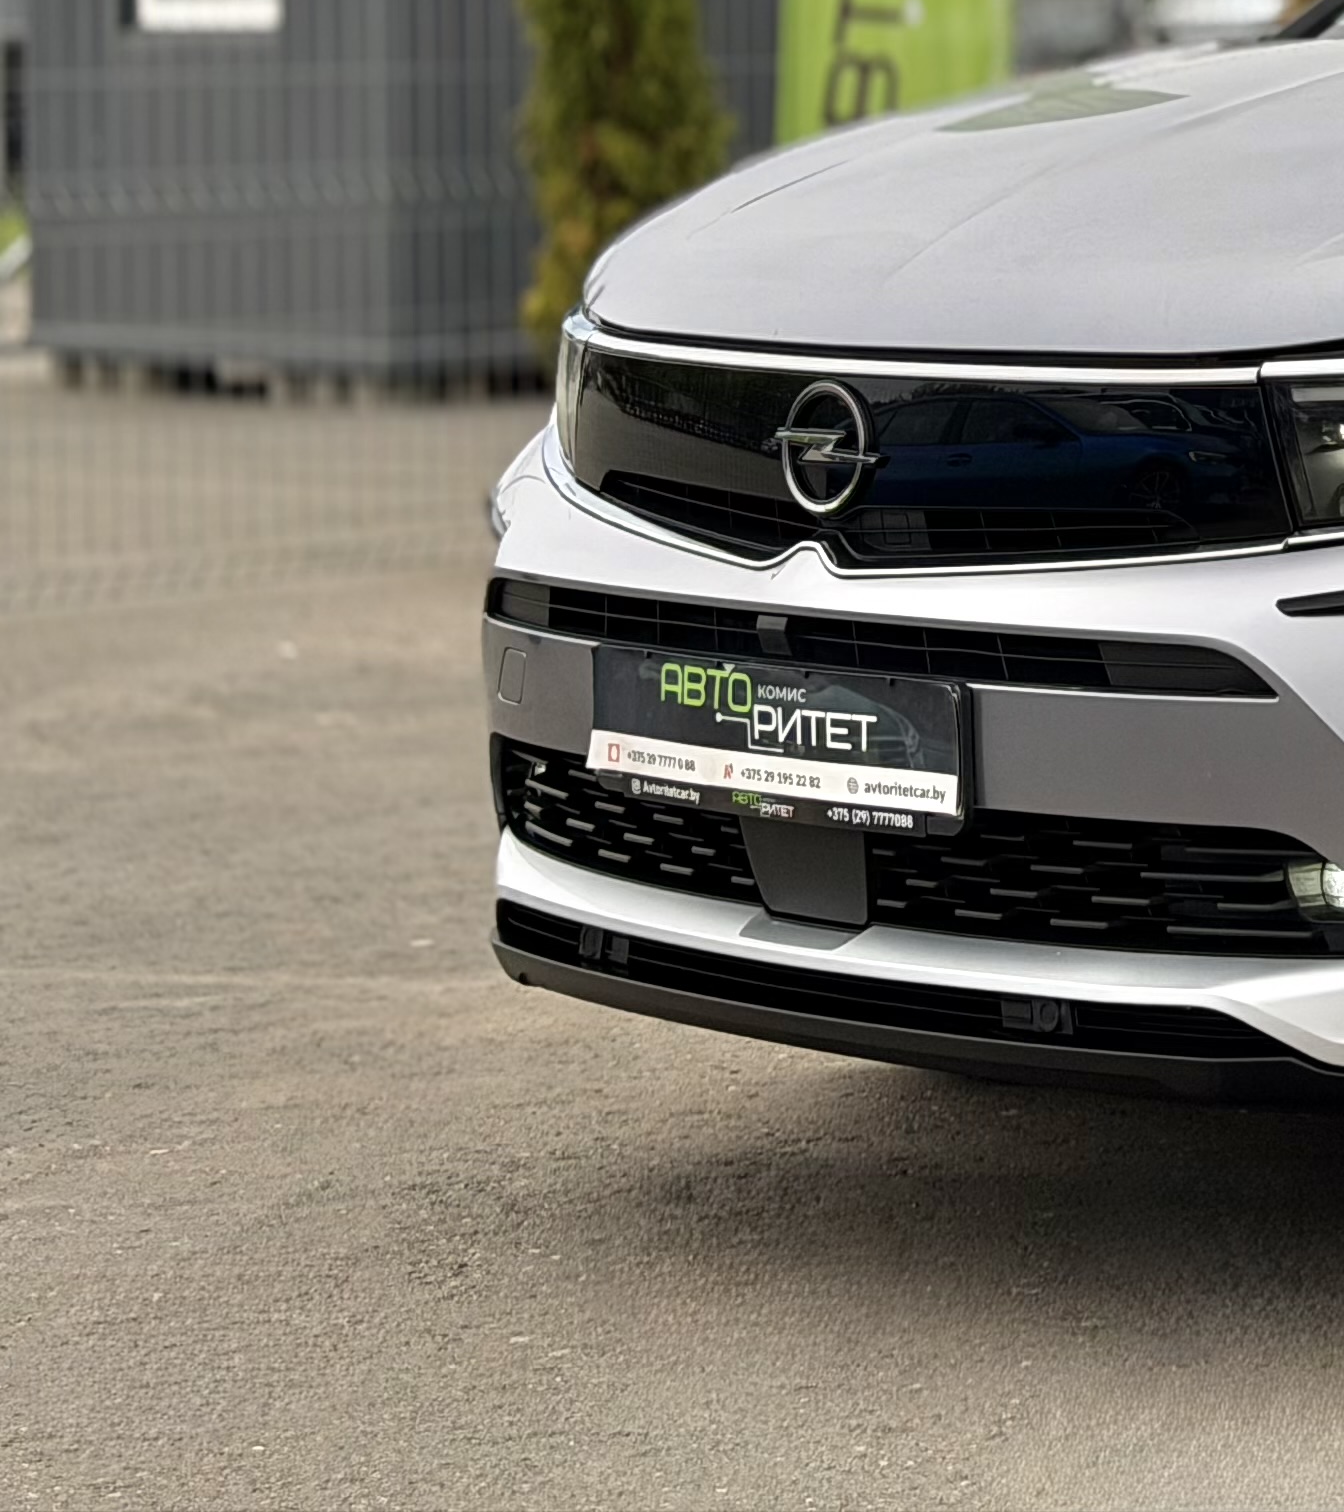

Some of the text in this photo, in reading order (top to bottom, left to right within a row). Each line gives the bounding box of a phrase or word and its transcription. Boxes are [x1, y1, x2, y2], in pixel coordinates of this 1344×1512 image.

[660, 662, 752, 713] АВТО
[757, 683, 807, 703] КОМИС
[753, 703, 878, 752] РИТЕТ
[740, 767, 762, 782] +375
[763, 769, 775, 783] 29
[777, 771, 793, 785] 195
[795, 774, 807, 787] 22
[864, 781, 947, 805] avtoritetcar.by
[826, 806, 850, 822] +375
[851, 808, 870, 826] (29)
